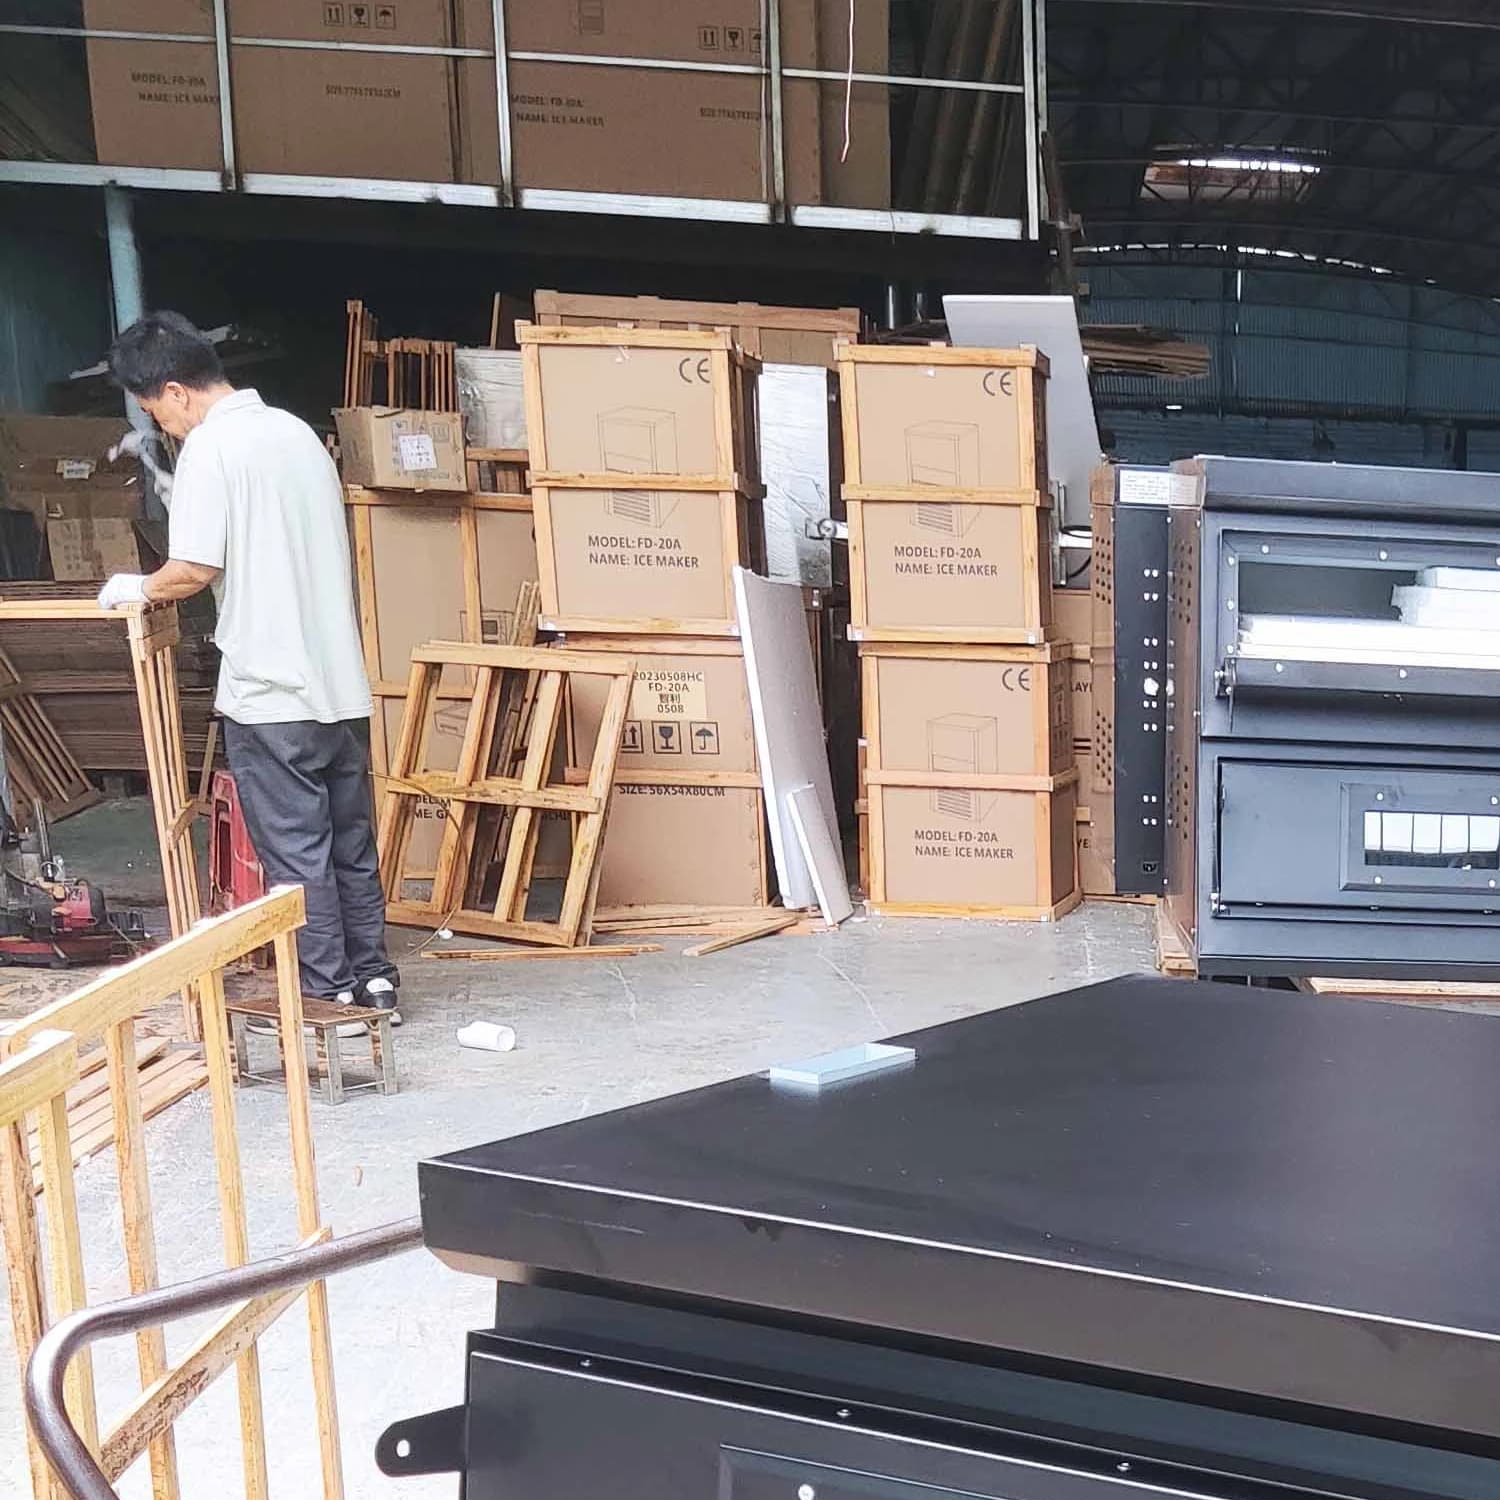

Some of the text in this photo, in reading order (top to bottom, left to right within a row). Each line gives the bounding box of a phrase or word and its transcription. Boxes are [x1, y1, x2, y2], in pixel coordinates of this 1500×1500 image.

[679, 358, 710, 383] CE
[983, 371, 1012, 396] CE
[588, 535, 682, 550] MODEL: FD-20A
[894, 545, 982, 559] MODEL: FD-20A
[589, 553, 699, 568] NAME: ICE MAKER
[895, 562, 998, 576] NAME: ICE MAKER
[1002, 668, 1031, 691] CE
[648, 682, 690, 692] FD-20A
[914, 830, 998, 842] MODEL: FD-20A
[915, 846, 1014, 859] NAME: ICE MAKER
